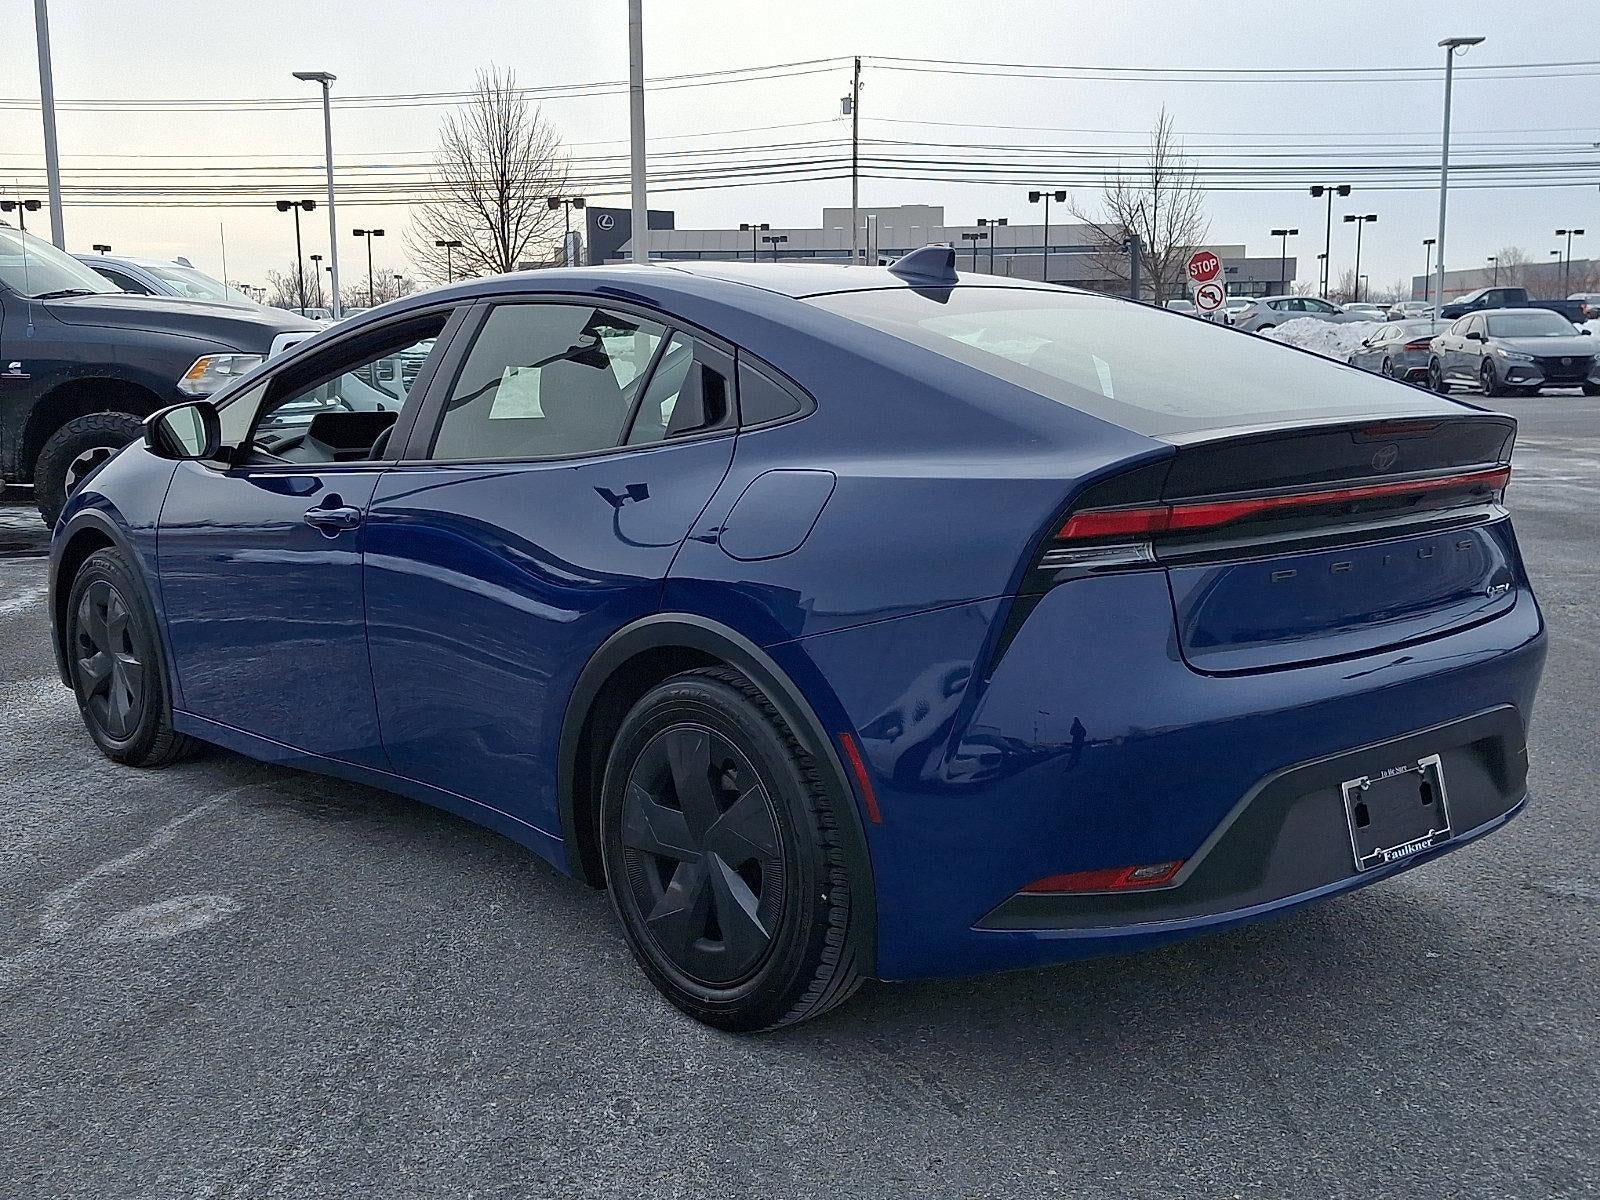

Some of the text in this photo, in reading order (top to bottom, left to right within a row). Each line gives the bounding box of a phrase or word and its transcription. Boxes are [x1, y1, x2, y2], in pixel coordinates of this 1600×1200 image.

[1190, 258, 1217, 276] STOP
[1271, 540, 1473, 583] PRIUS
[1383, 839, 1434, 862] Faulkner
